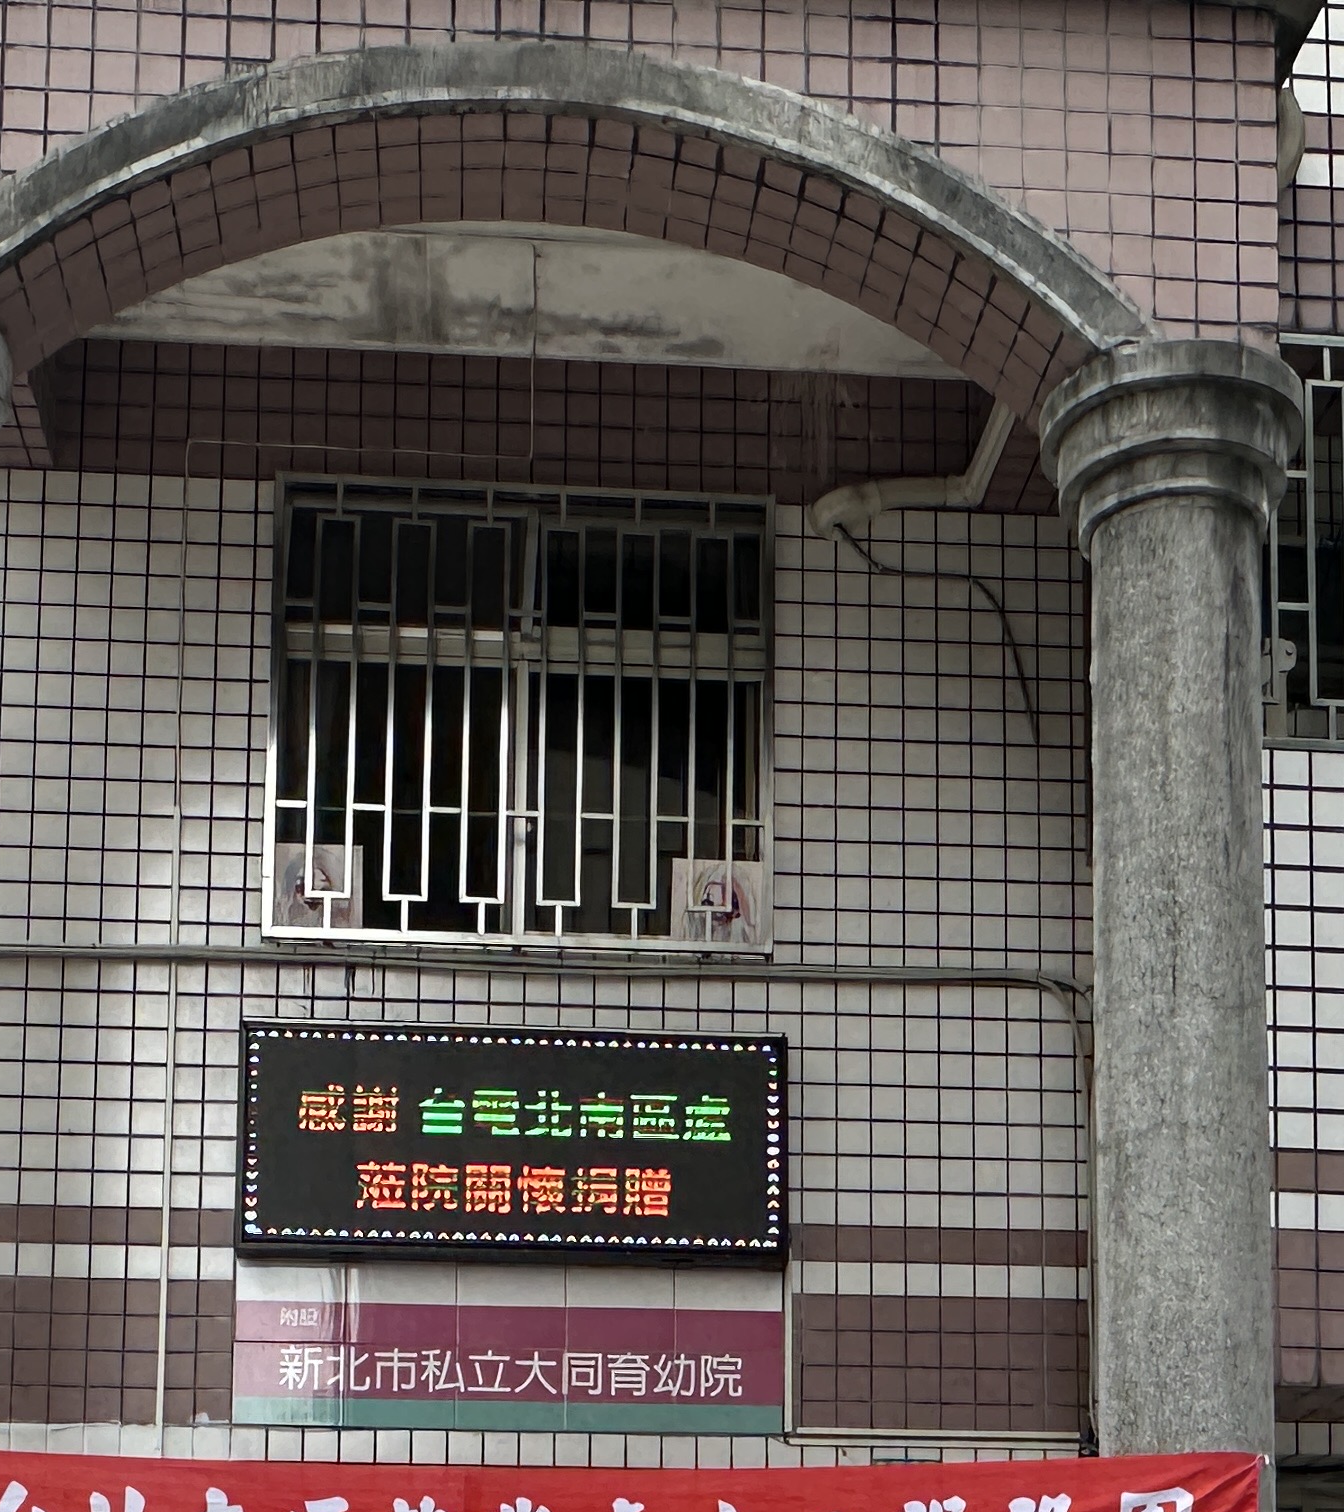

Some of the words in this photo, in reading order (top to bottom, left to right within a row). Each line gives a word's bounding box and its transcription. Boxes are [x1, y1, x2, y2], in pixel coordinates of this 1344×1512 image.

[299, 1084, 398, 1132] 感謝
[279, 1345, 743, 1397] 新北市私立大同育幼院
